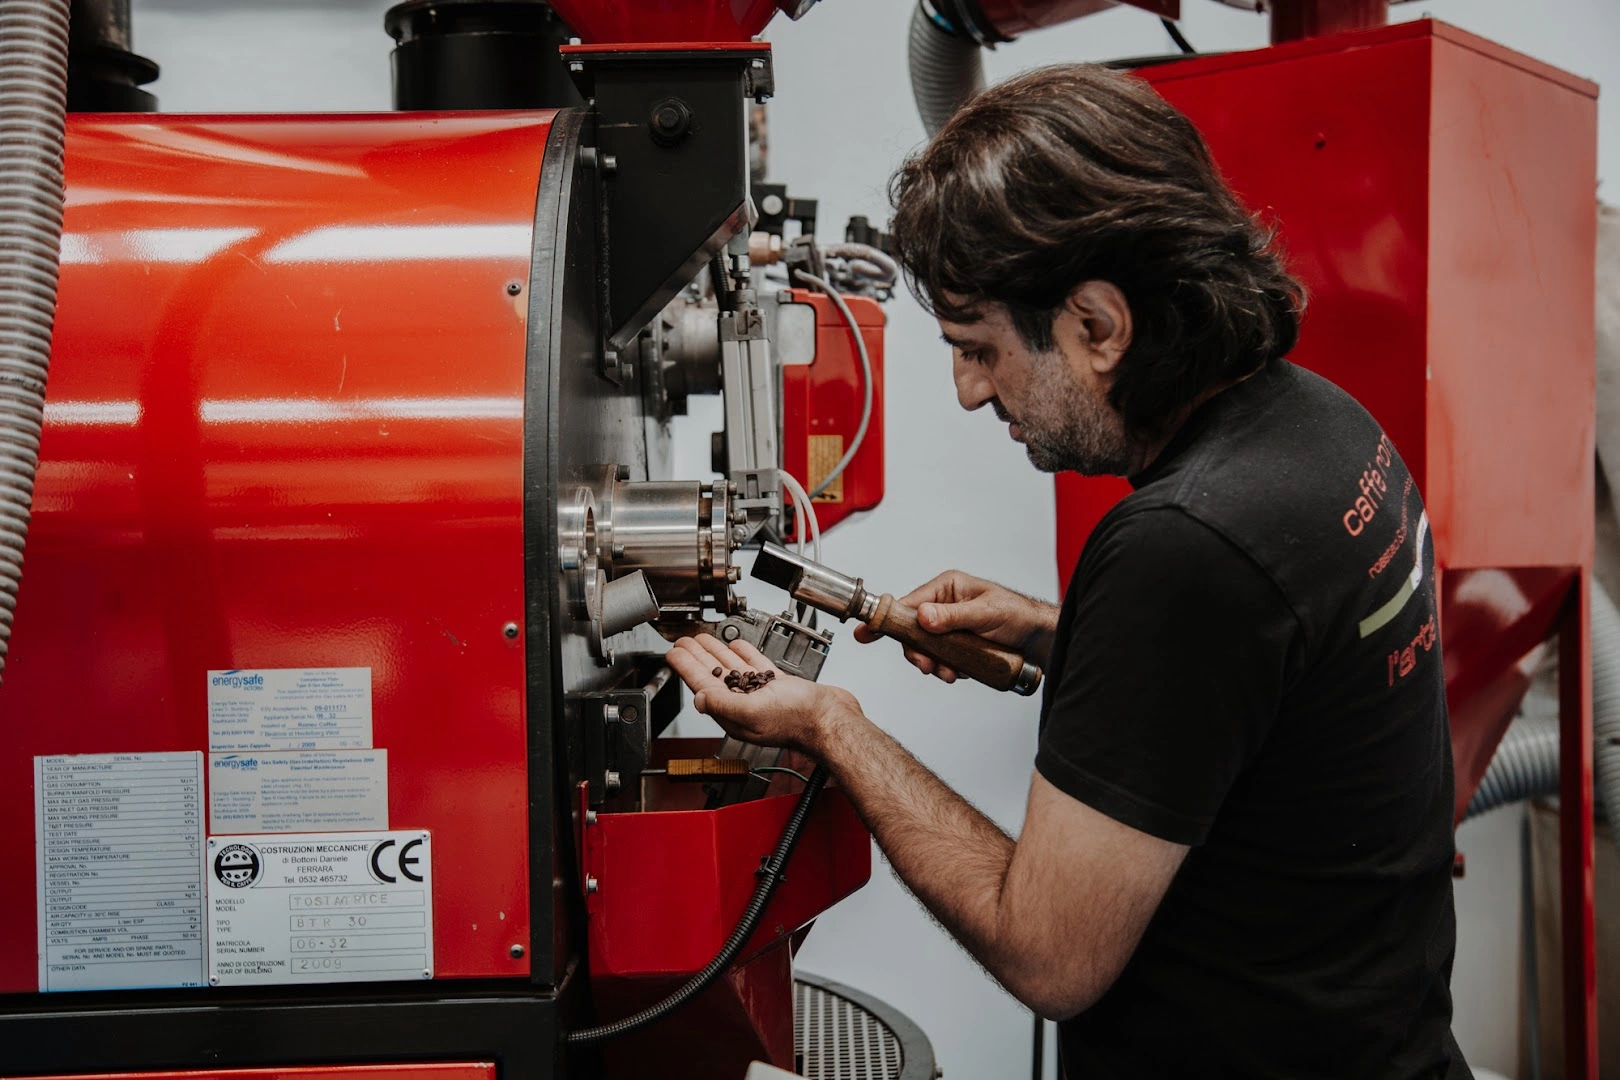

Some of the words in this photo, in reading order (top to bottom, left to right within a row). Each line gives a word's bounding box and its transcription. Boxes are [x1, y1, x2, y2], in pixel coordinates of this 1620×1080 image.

[212, 674, 264, 688] energysafe
[213, 758, 258, 769] energysafe
[220, 845, 254, 857] TECNOLOGIE
[261, 846, 315, 854] COSTRUZIONI
[316, 844, 369, 852] MECCANICHE
[371, 839, 424, 883] CE
[348, 916, 367, 927] 30
[300, 959, 342, 969] 2009
